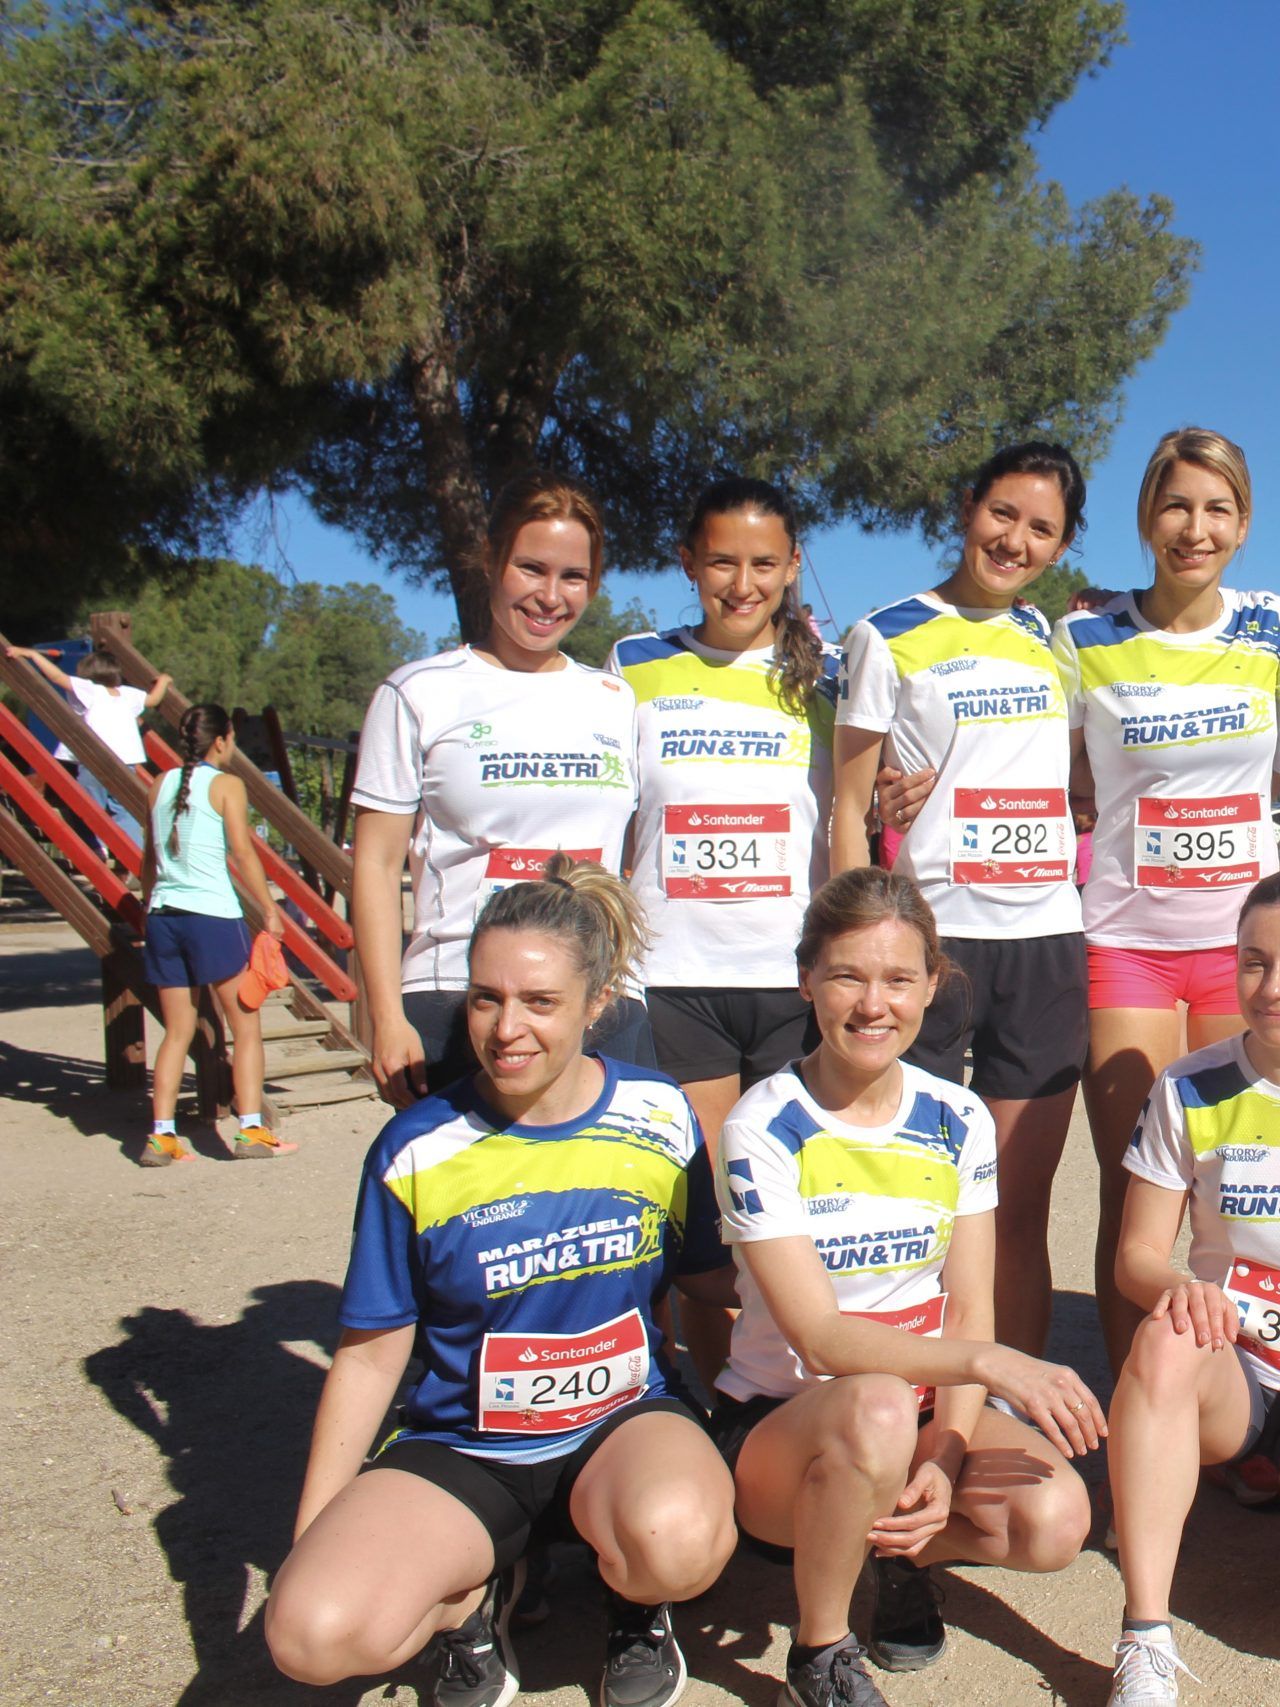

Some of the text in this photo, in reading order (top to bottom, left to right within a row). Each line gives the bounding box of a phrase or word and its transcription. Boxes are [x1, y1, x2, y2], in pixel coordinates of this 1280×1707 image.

[947, 684, 1050, 700] MARAZUELA
[1120, 702, 1250, 726] MARAZUELA
[660, 729, 787, 739] MARAZUELA
[479, 752, 603, 762] MARAZUELA
[998, 798, 1050, 810] Santander
[1180, 806, 1239, 820] Santander
[703, 814, 765, 826] Santander
[991, 823, 1048, 854] 282
[1173, 829, 1235, 861] 395
[696, 839, 761, 870] 334
[461, 1200, 516, 1223] VICTORY
[472, 1209, 524, 1228] ENDURANCE
[478, 1214, 641, 1264] MARAZUELA
[540, 1337, 618, 1362] Santander
[530, 1365, 611, 1405] 240
